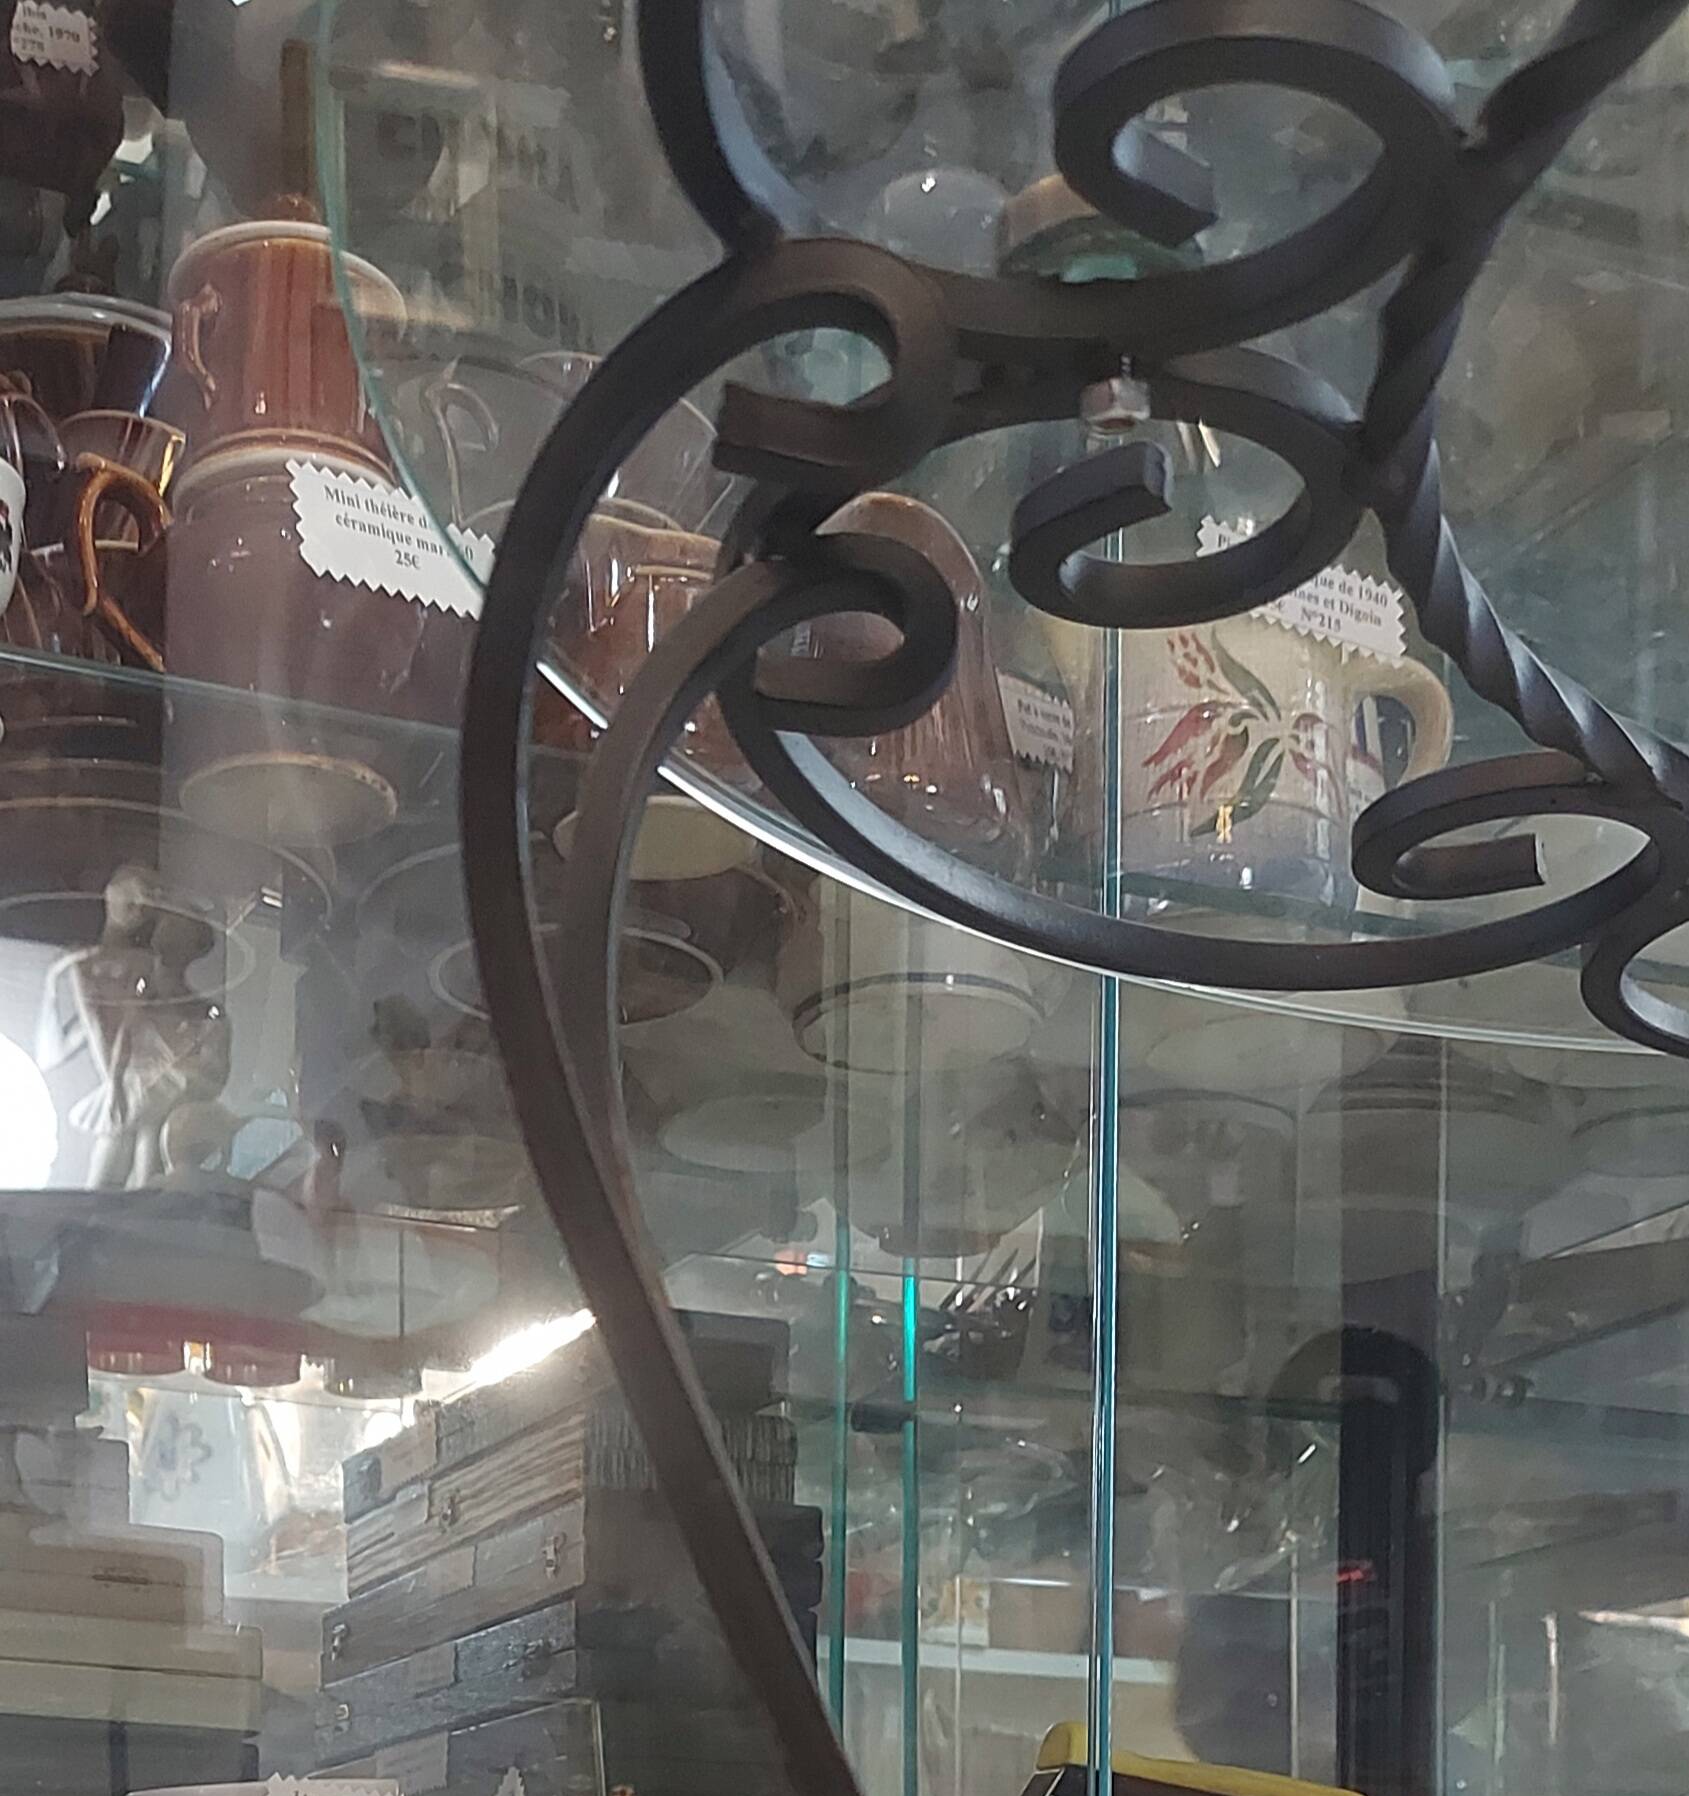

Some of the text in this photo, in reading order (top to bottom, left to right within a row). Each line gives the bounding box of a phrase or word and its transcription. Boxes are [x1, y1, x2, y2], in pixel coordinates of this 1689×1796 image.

[324, 485, 361, 510] Mini
[364, 498, 415, 524] théière
[335, 512, 412, 546] céramique
[394, 549, 421, 570] 25€
[1323, 595, 1335, 610] et
[1338, 577, 1354, 597] de
[1357, 580, 1388, 608] 1940
